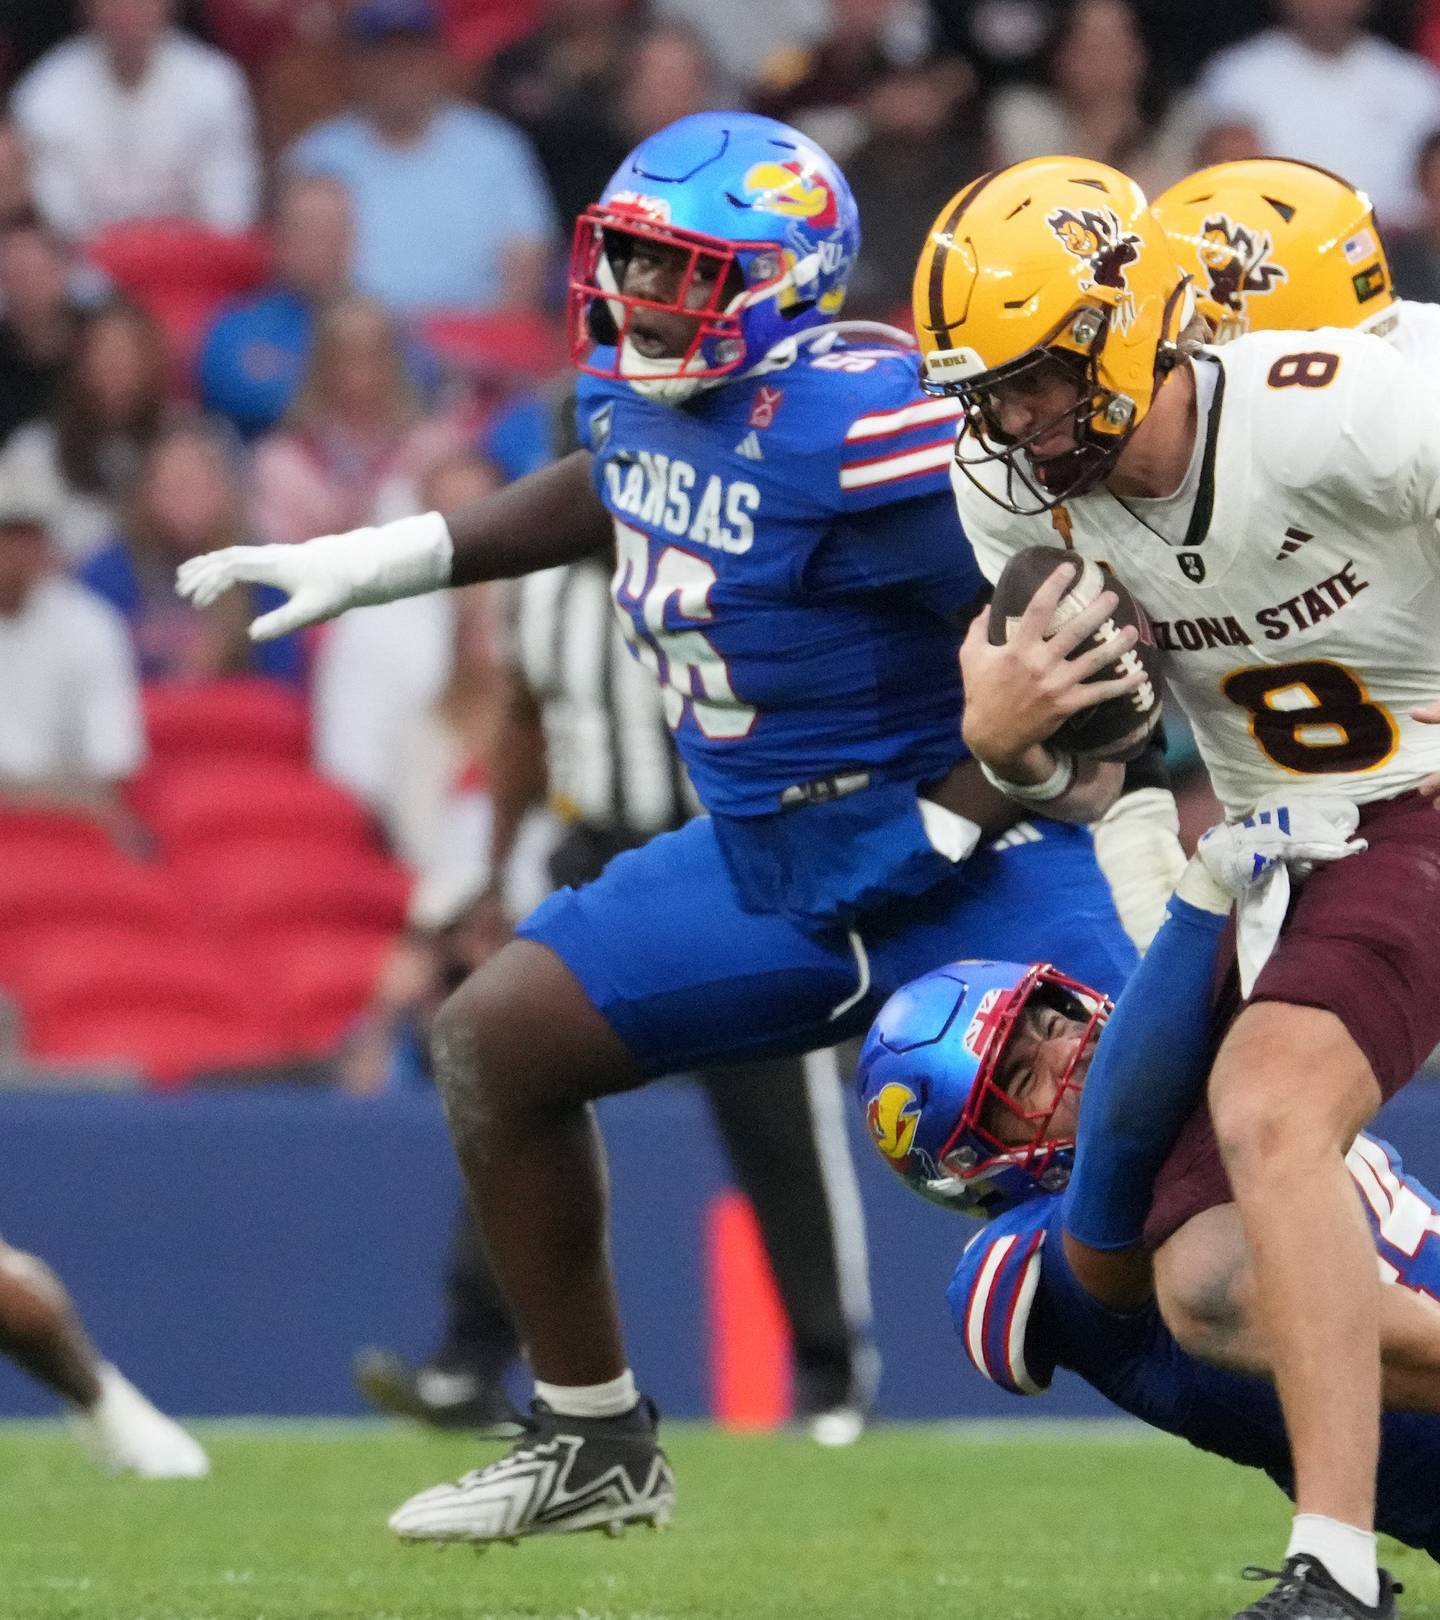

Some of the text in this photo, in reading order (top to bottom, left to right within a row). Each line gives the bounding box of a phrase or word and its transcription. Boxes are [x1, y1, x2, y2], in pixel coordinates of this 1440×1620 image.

[1268, 351, 1341, 390] 8
[1255, 559, 1370, 640] STATE
[1222, 658, 1400, 775] 8
